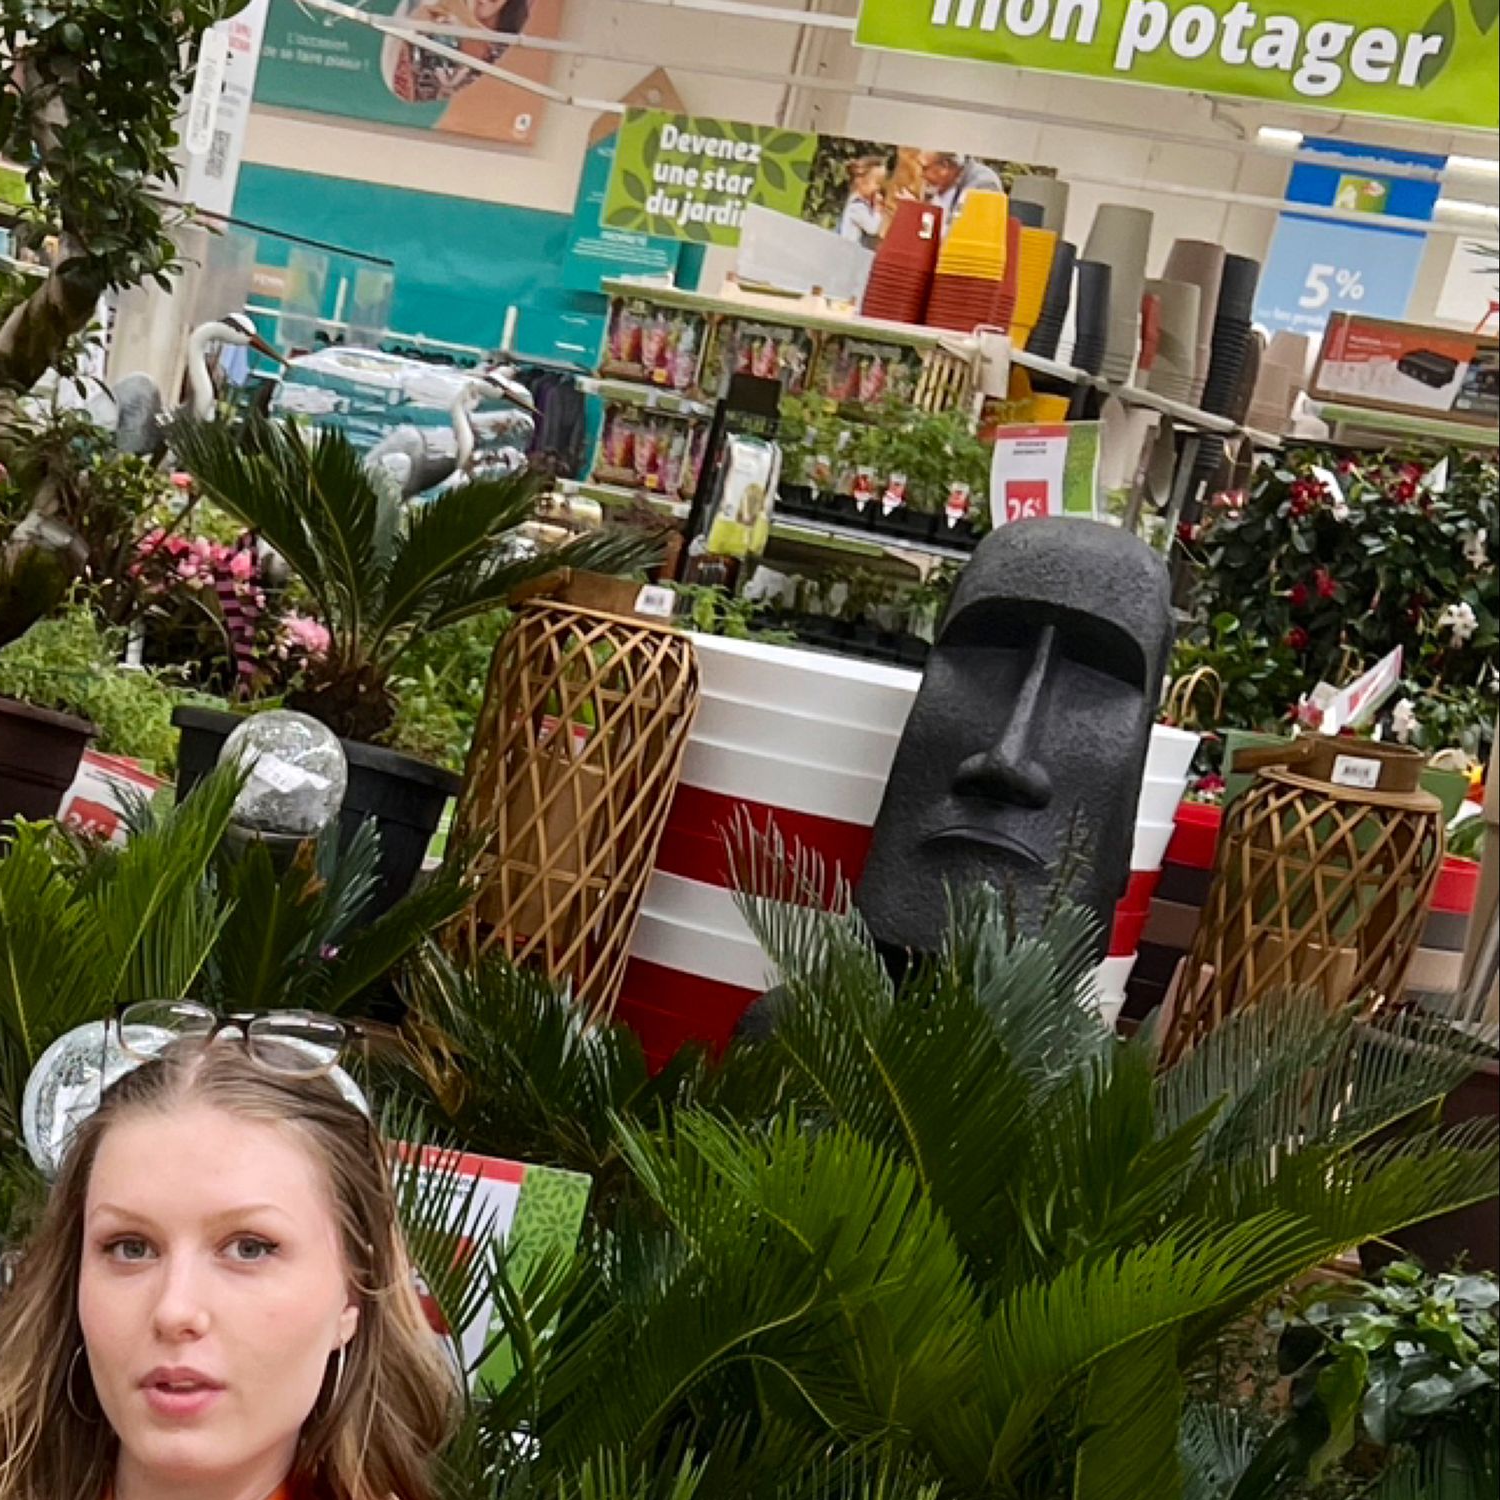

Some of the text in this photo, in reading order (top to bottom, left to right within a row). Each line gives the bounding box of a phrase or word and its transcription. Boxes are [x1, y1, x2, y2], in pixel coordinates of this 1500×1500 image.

[1114, 0, 1443, 95] potager
[660, 123, 762, 164] Devenez
[653, 162, 754, 195] une star
[645, 188, 678, 216] du
[1298, 262, 1365, 309] 5%
